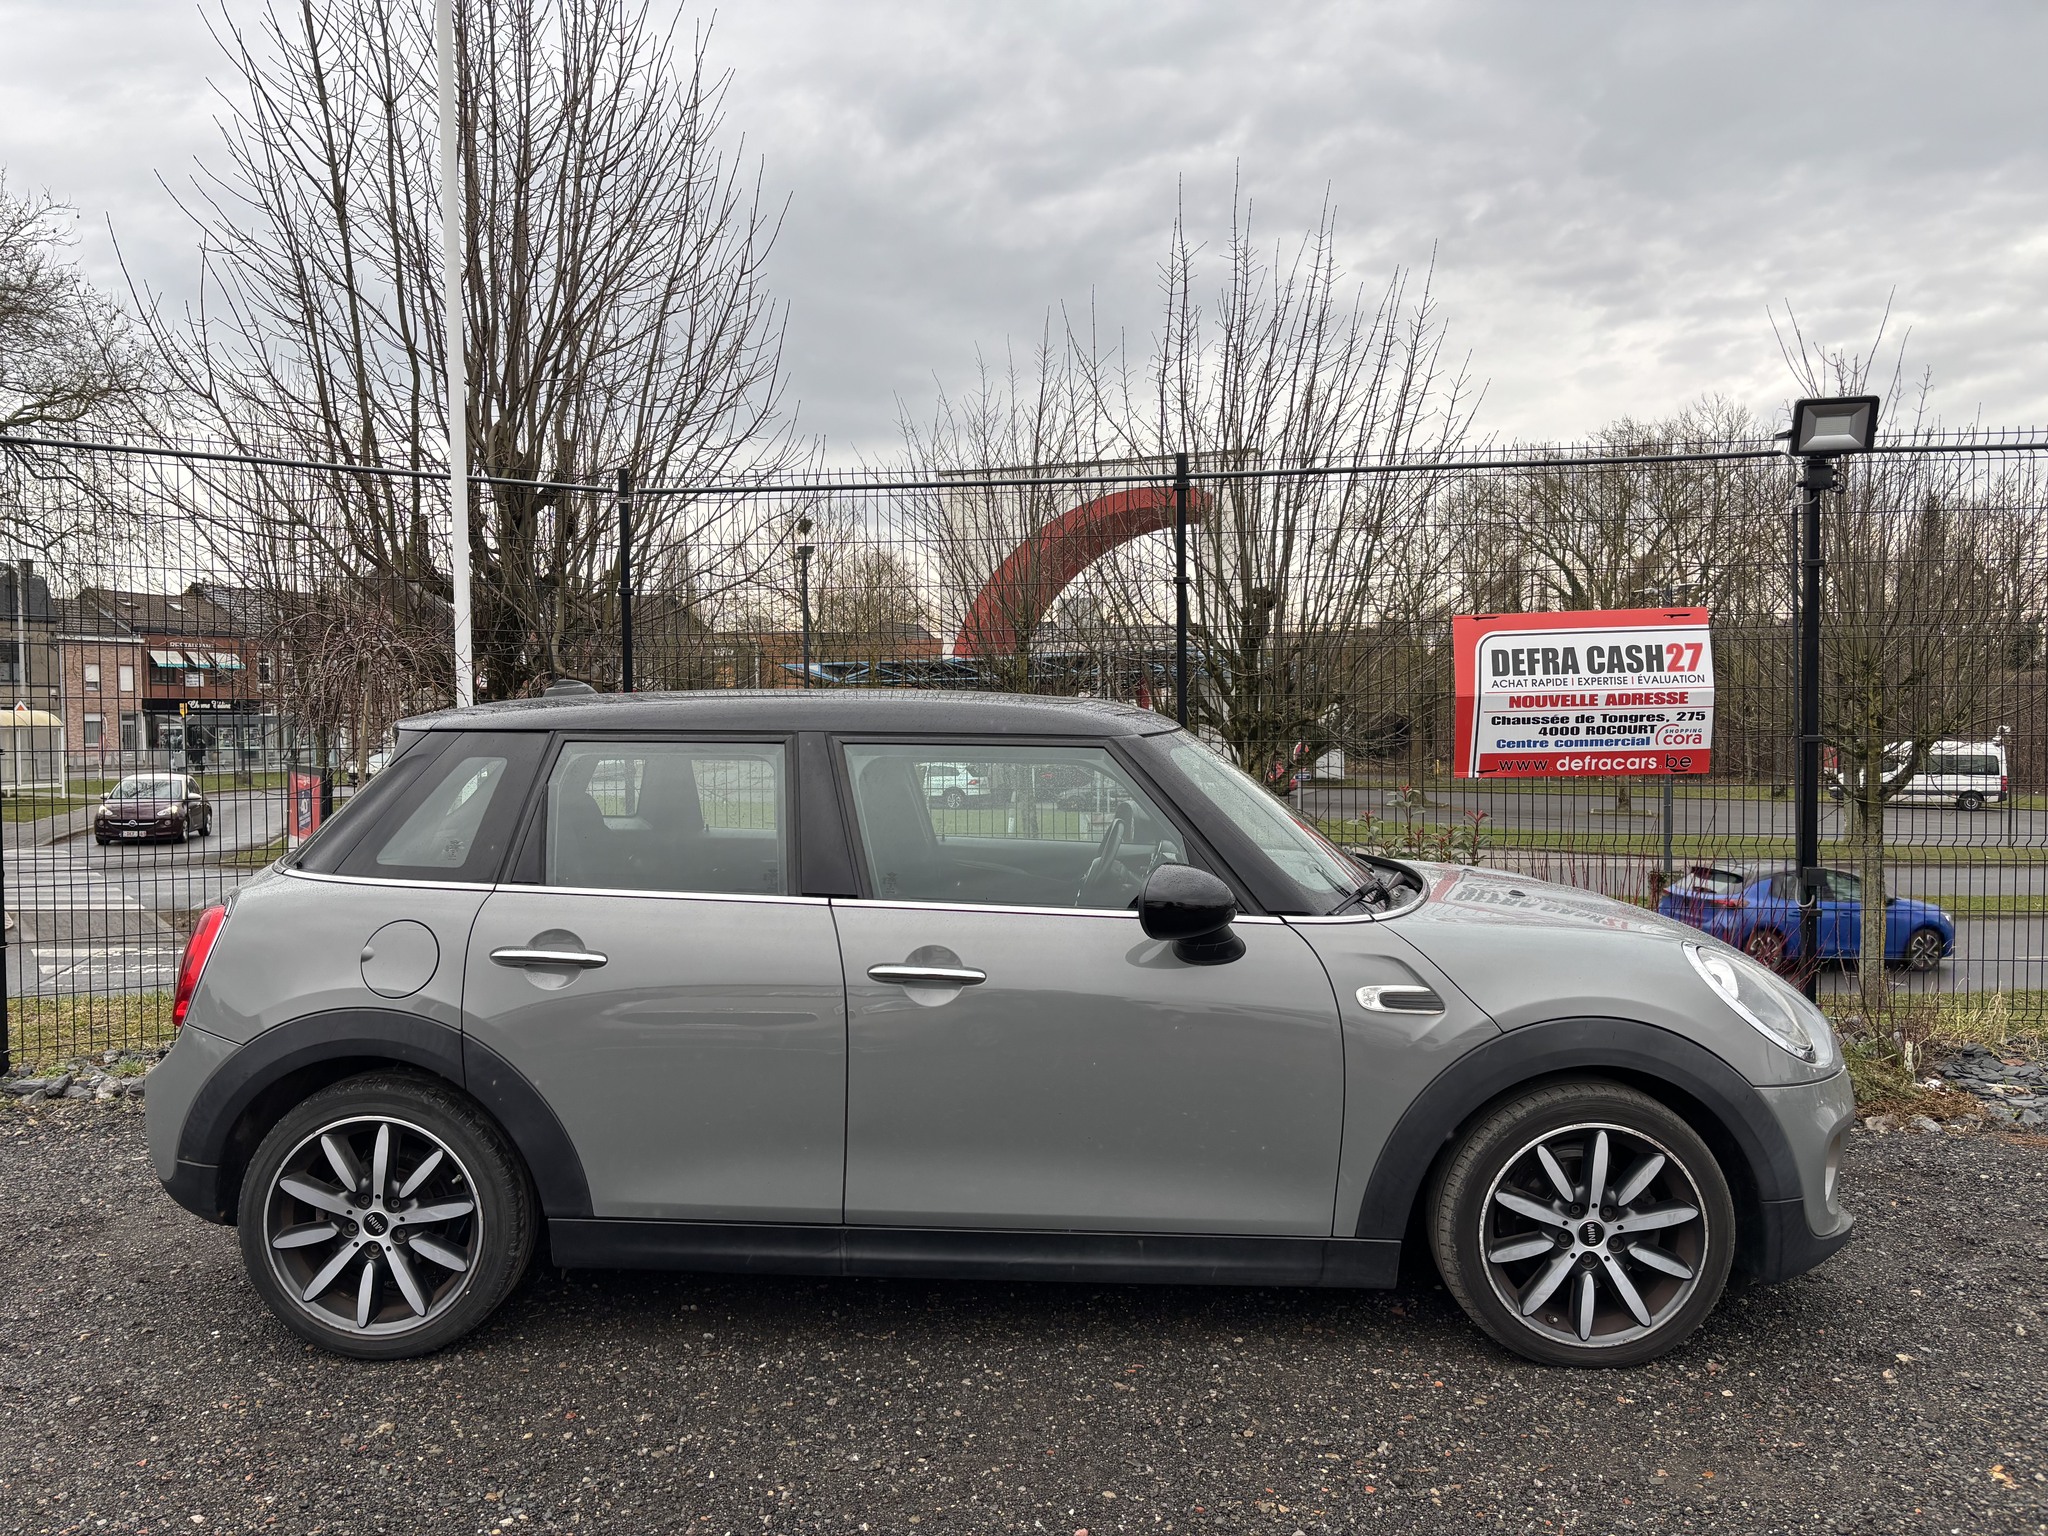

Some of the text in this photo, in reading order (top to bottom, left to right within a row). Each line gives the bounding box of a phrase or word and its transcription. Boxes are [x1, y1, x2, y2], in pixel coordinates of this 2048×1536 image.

[1491, 647, 1580, 676] DEFRA
[1491, 674, 1705, 688] ACHAT RAPIDE EXPERTISE ÉVALUATION
[1509, 692, 1689, 708] NOUVELLE ADRESSE
[1491, 711, 1705, 725] Chaussée de Tongres, 275
[1538, 724, 1657, 736] 4000 ROCOURT
[1496, 737, 1650, 749] Centre commercial
[1663, 733, 1702, 745] cora
[1499, 754, 1692, 772] www.defracars.be
[367, 1214, 385, 1233] MINI
[1587, 1223, 1597, 1244] MINI
